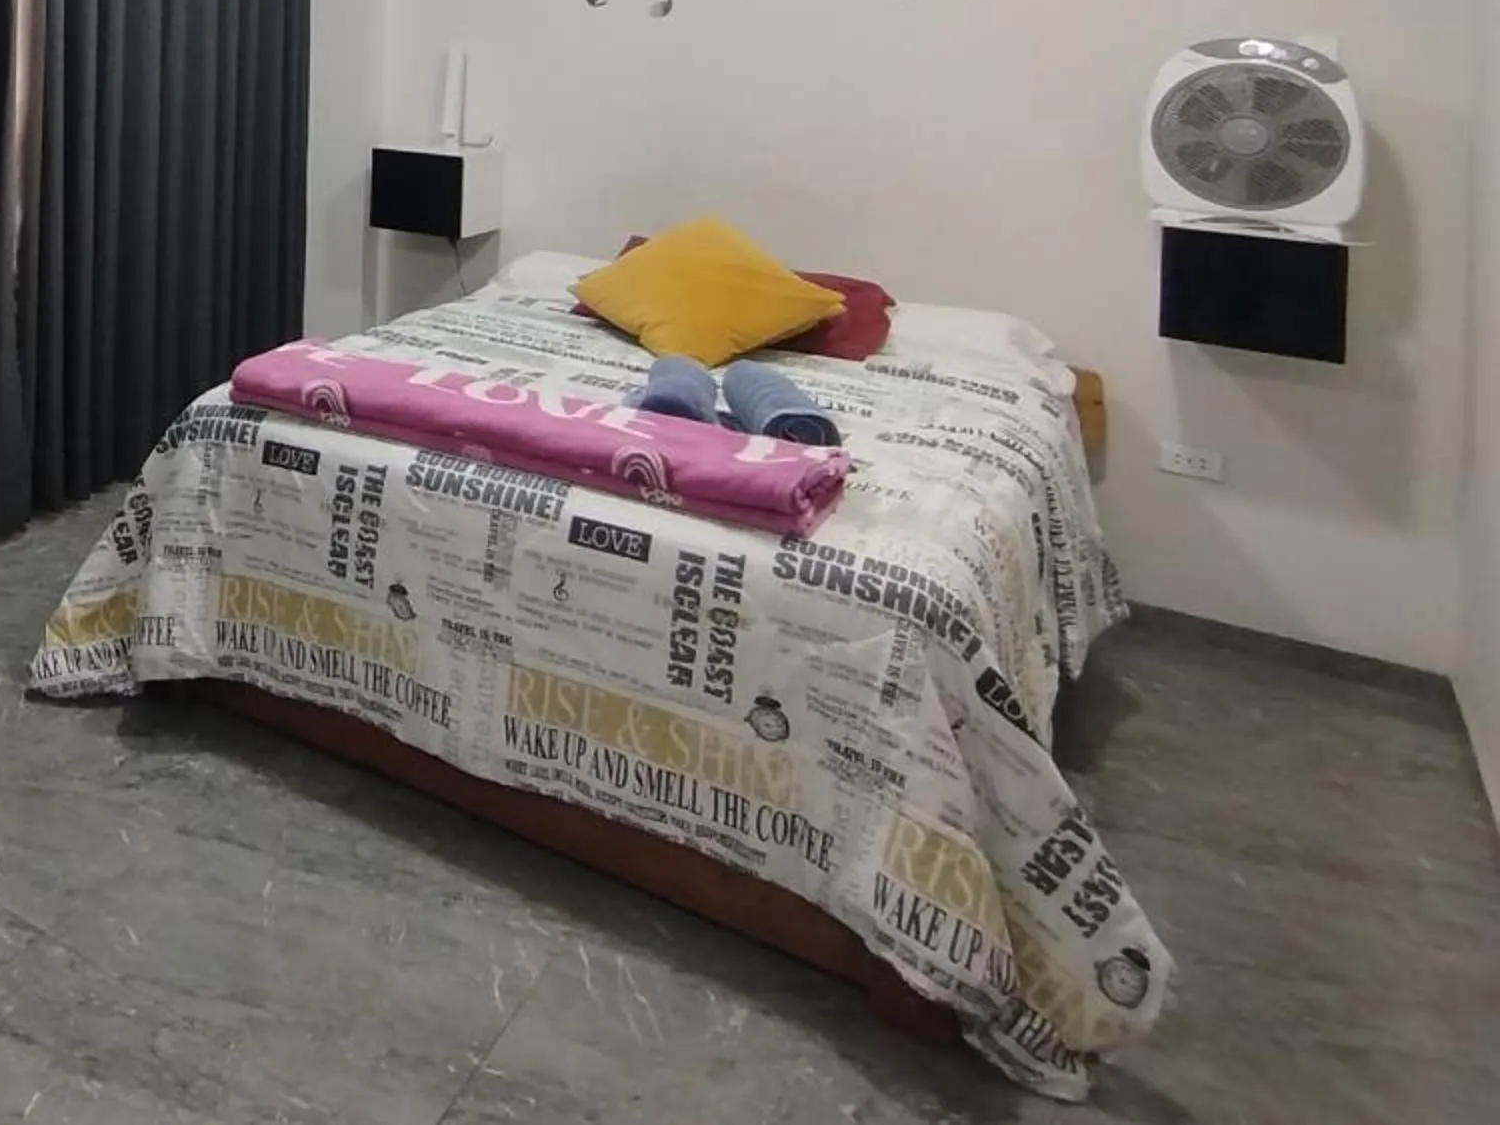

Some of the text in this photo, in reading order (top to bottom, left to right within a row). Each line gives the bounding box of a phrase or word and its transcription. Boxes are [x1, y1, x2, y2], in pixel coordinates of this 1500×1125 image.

[270, 445, 315, 473] LOVE
[416, 450, 572, 498] GOOD MORNING
[406, 463, 567, 523] SUNSHINE!
[355, 464, 388, 590] THE COAST
[577, 521, 644, 558] LOVE
[781, 535, 856, 567] GOOD
[220, 576, 285, 625] RISE
[703, 552, 747, 705] THE COAST
[772, 552, 983, 663] SUNSHINE!
[215, 620, 259, 654] WAKE
[279, 636, 307, 671] AND
[309, 644, 360, 686] SMELL
[362, 659, 393, 699] THE
[395, 673, 451, 728] COFFEE
[510, 670, 604, 729] RISE
[503, 714, 560, 762] WAKE
[564, 730, 588, 775] UP
[590, 745, 629, 790] AND
[631, 759, 704, 818] SMELL
[709, 784, 751, 836] THE
[873, 871, 947, 952] WAKE
[949, 919, 984, 972] UP
